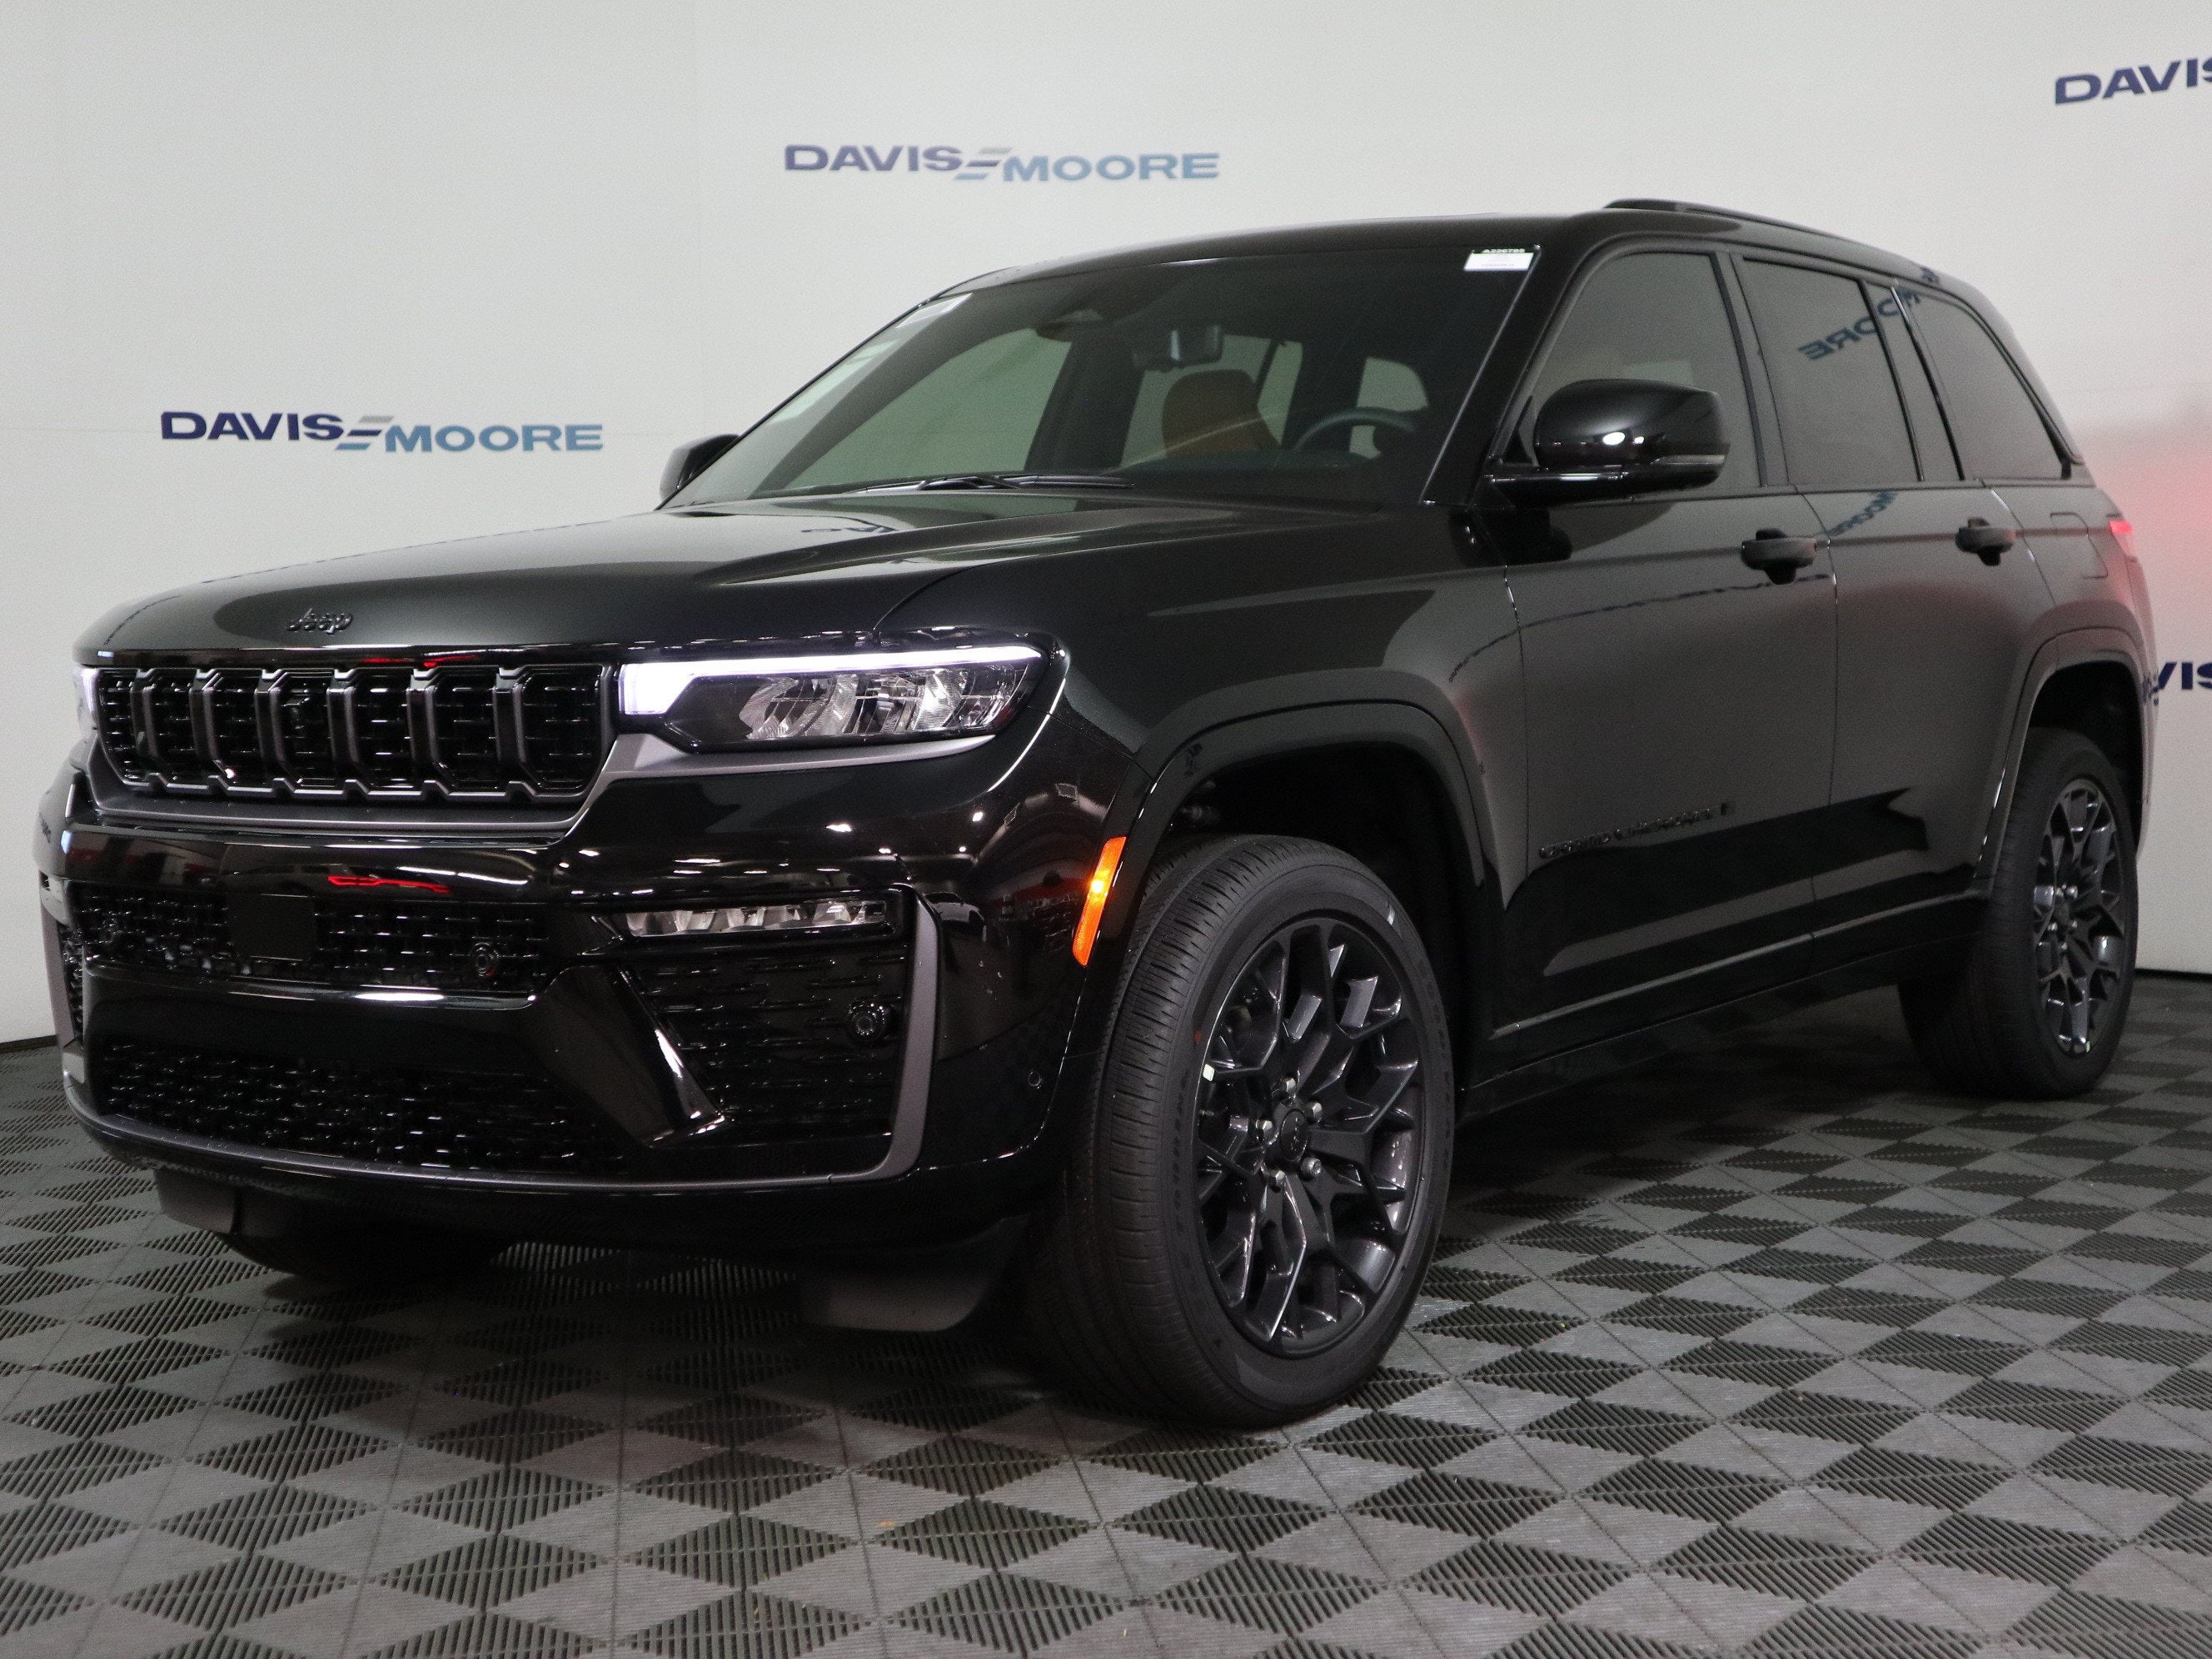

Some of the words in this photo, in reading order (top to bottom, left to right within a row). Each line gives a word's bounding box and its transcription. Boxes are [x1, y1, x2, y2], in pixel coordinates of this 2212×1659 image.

[2055, 57, 2212, 104] DAVI
[784, 145, 964, 172] DAVIS
[1002, 152, 1219, 182] MOORE
[161, 411, 345, 441] DAVIS
[385, 424, 604, 453] MOORE
[286, 608, 353, 635] Jeep
